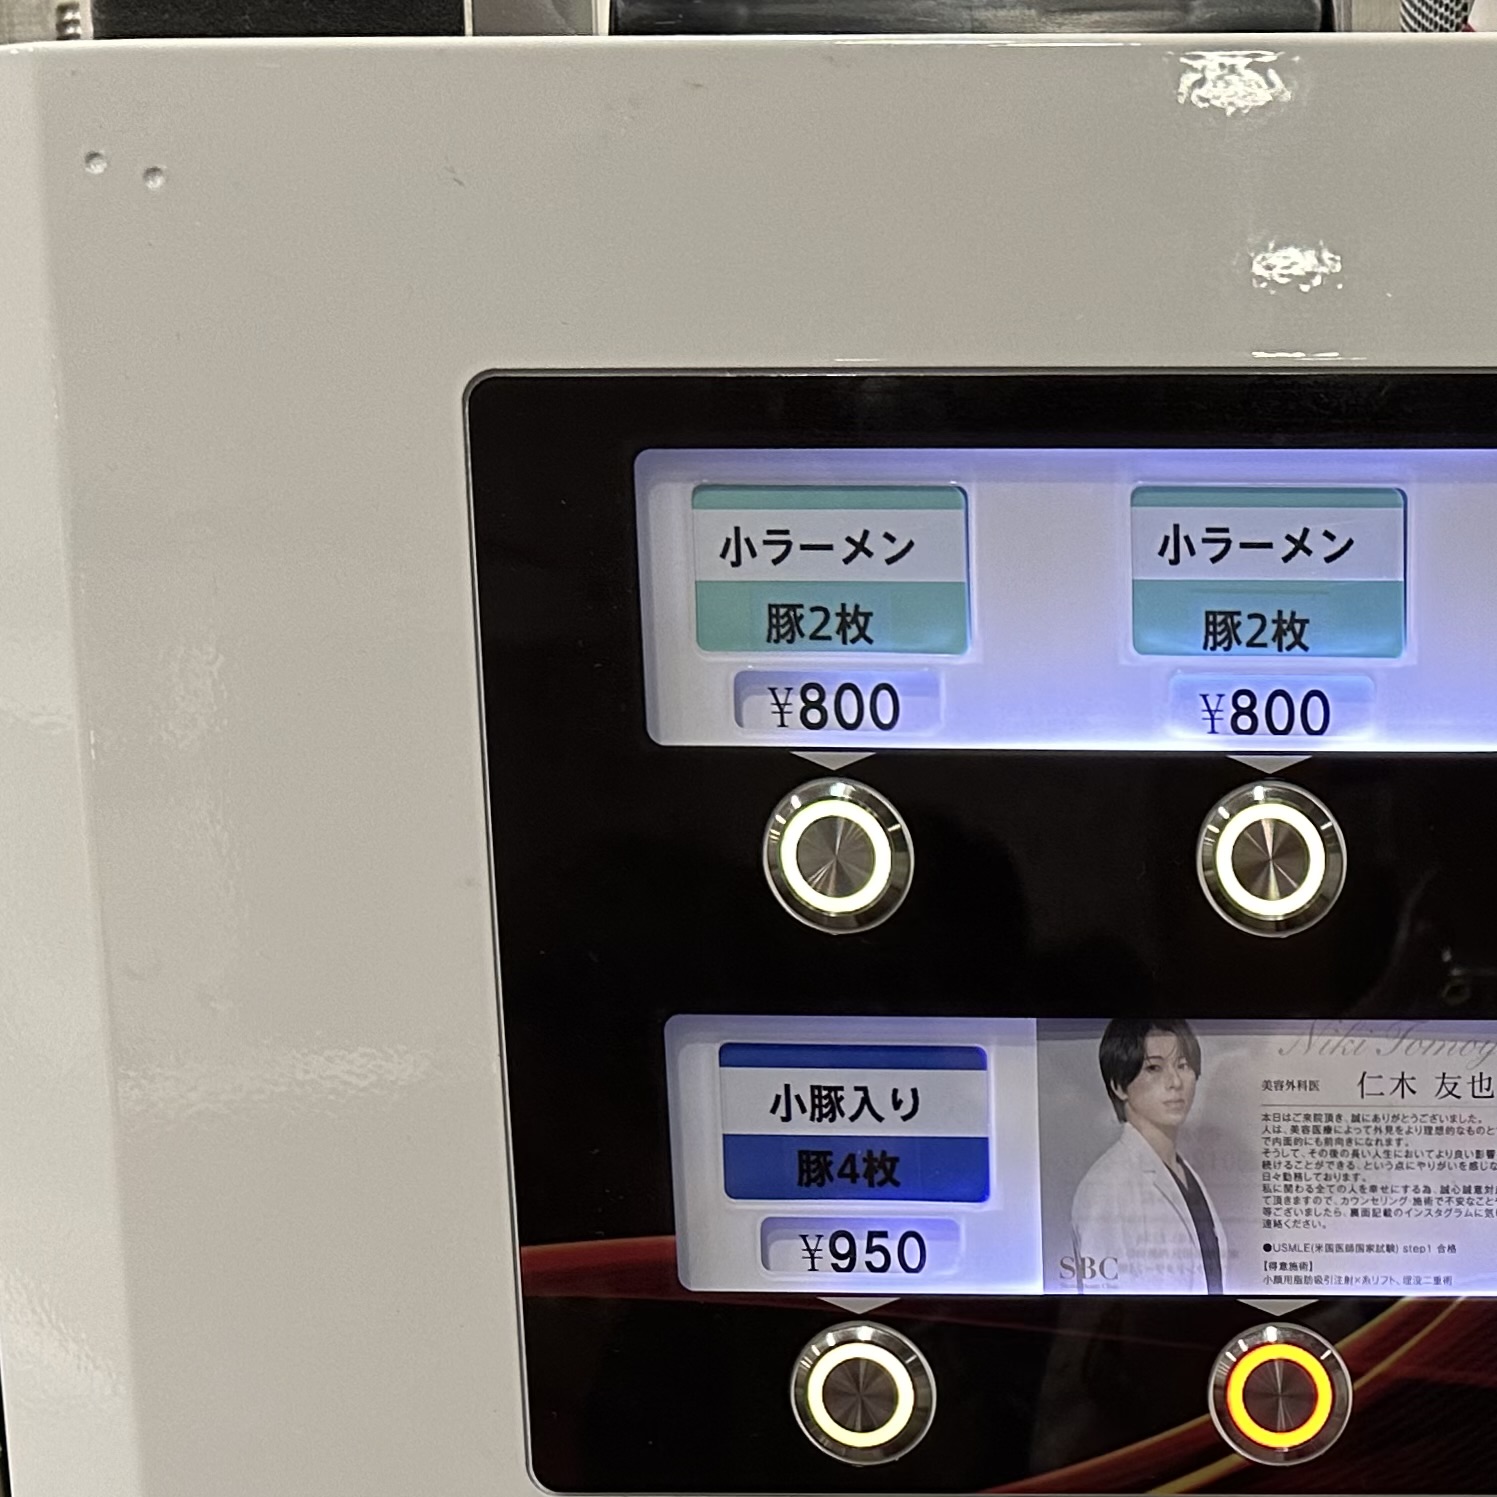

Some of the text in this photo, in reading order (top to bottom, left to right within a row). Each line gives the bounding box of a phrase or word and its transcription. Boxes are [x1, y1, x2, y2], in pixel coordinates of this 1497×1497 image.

[719, 526, 915, 567] 小ラーメン
[1157, 524, 1355, 565] 小ラーメン
[765, 603, 874, 646] 豚2枚
[1202, 610, 1310, 654] 豚2枚
[767, 683, 901, 732] ¥800
[1200, 689, 1330, 737] ¥800
[769, 1083, 920, 1123] 小豚入り
[1262, 1071, 1496, 1100] 美容外科医 仁木 友也
[797, 1150, 901, 1188] 豚4枚
[798, 1230, 926, 1274] ¥950
[1059, 1256, 1119, 1280] SBC
